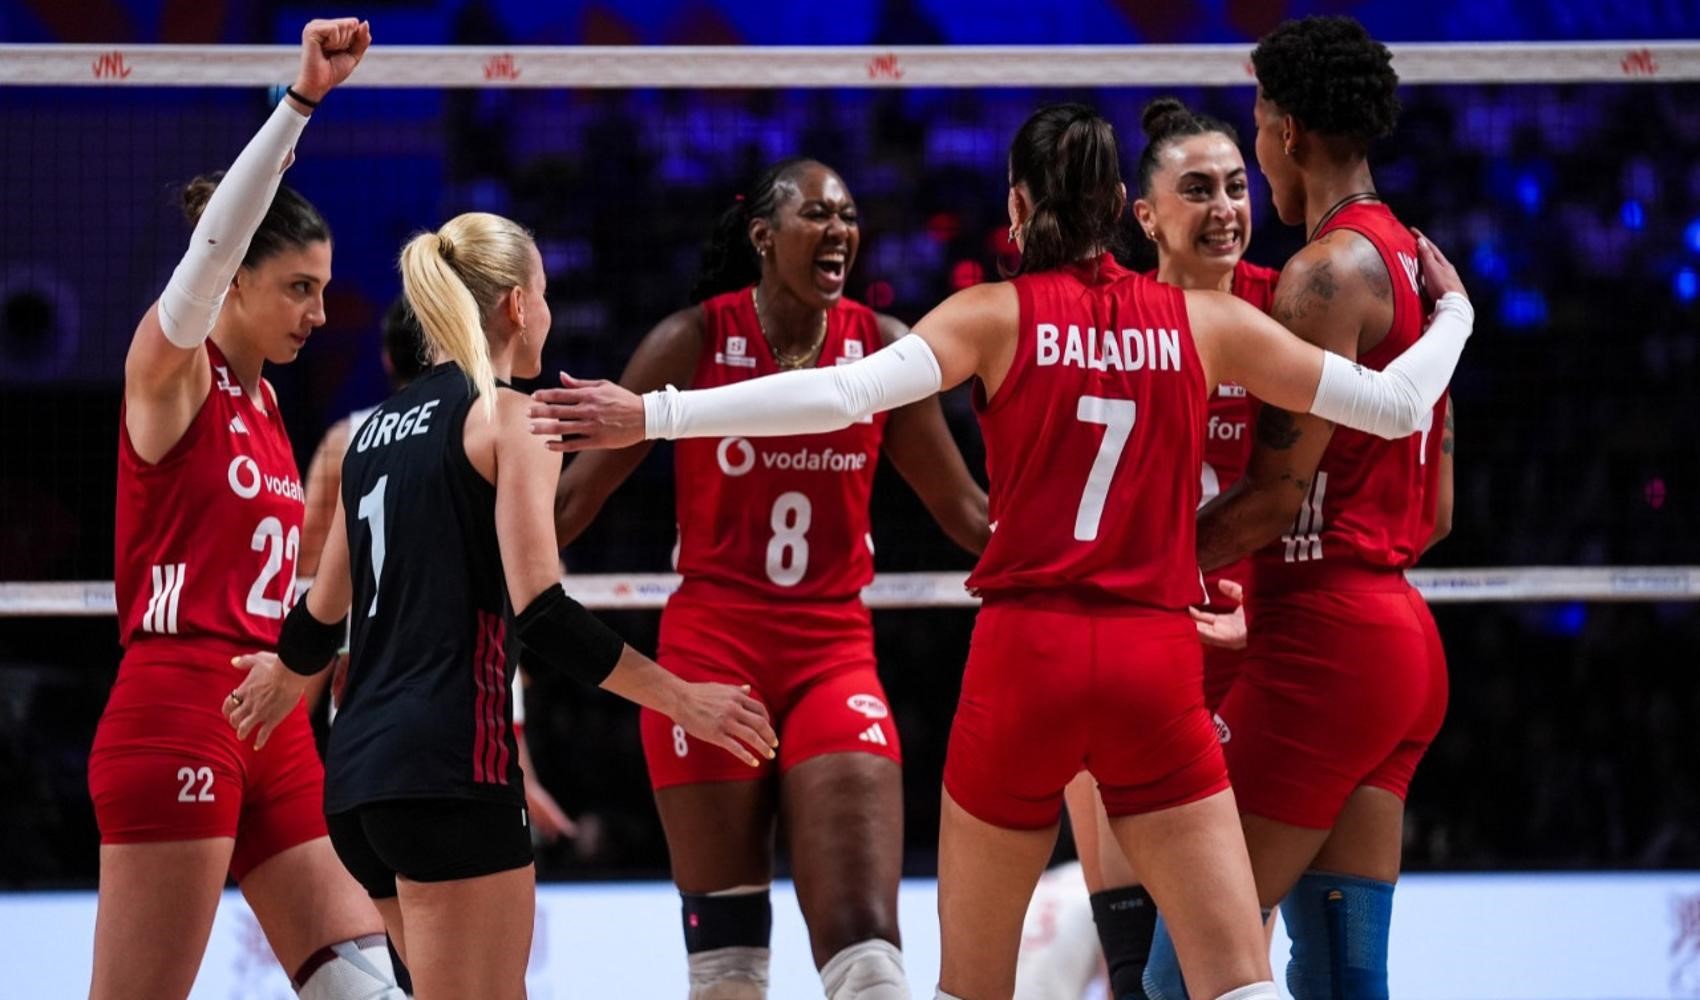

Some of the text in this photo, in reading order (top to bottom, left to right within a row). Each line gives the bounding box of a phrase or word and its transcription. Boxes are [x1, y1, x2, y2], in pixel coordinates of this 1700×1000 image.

[1036, 323, 1181, 372] BALADIN
[357, 399, 441, 453] ÖRGE
[762, 449, 867, 471] vodafone
[1074, 395, 1136, 541] 7
[264, 473, 305, 504] vodaf
[358, 474, 388, 617] 1
[765, 491, 812, 587] 8
[246, 516, 299, 620] 22
[672, 724, 688, 757] 8
[177, 766, 215, 802] 22
